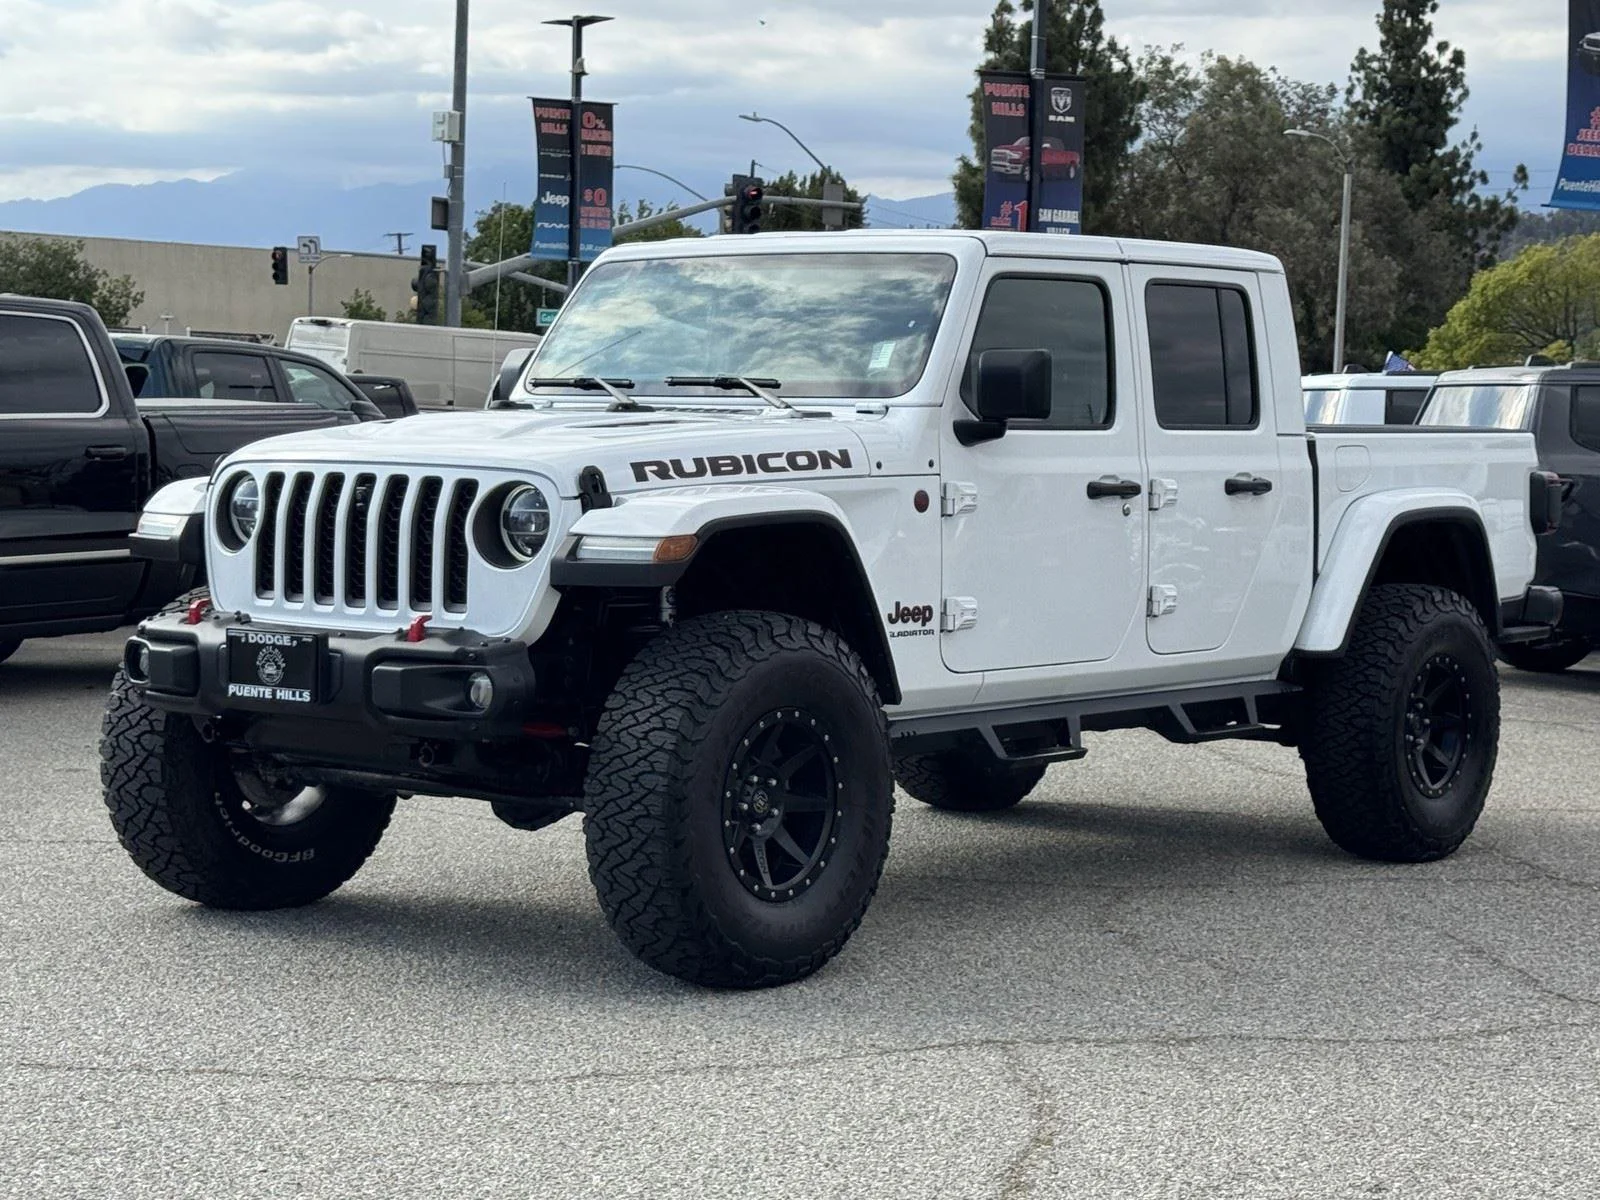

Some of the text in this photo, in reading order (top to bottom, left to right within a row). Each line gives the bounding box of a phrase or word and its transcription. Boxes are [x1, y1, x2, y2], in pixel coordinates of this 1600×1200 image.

[991, 101, 1025, 116] HILLS
[541, 191, 569, 207] Jeep
[630, 449, 853, 482] RUBICON
[887, 601, 934, 627] Jeep
[228, 684, 311, 702] PUENTE HILLS
